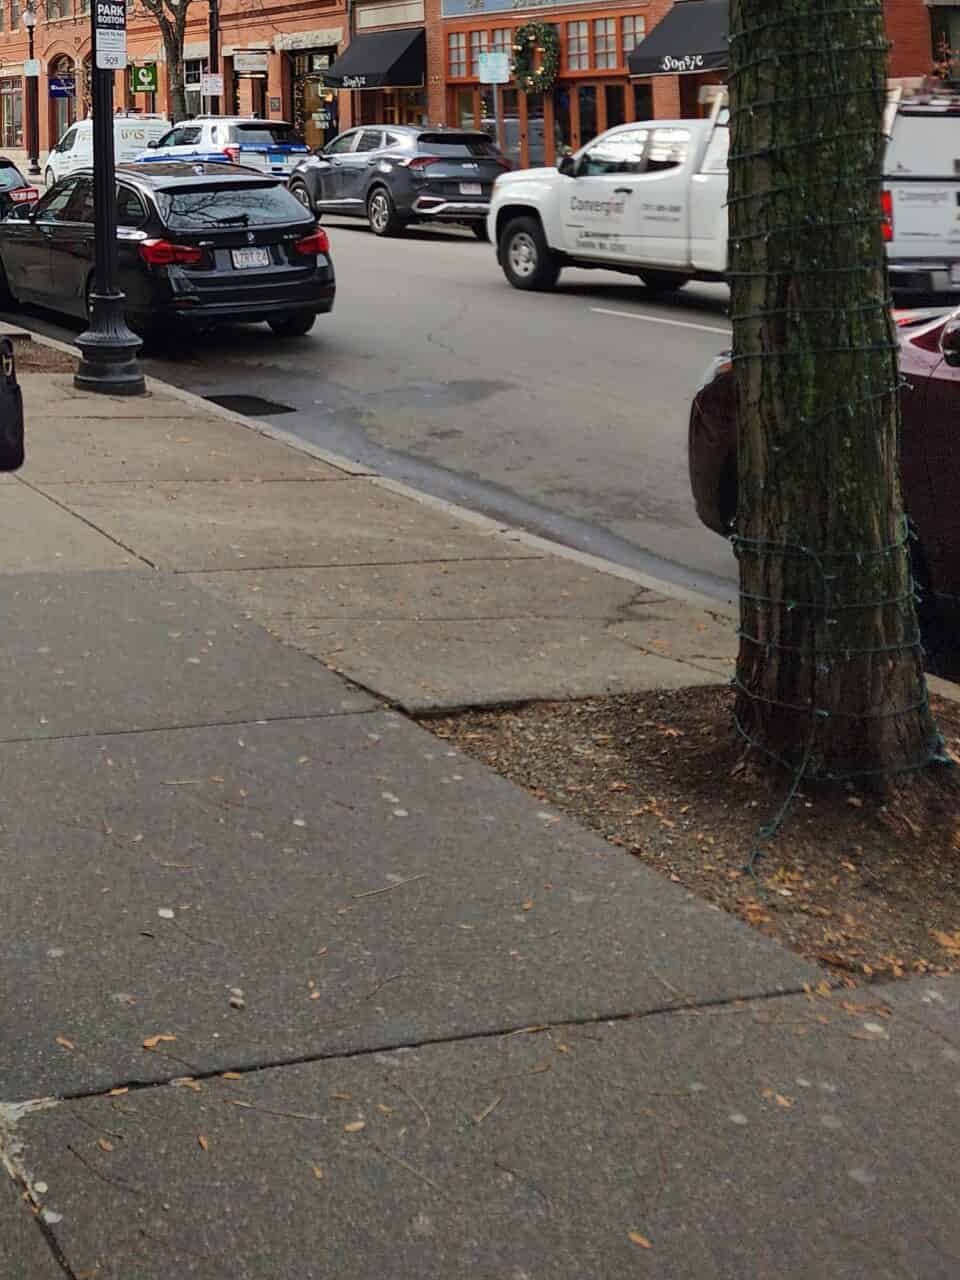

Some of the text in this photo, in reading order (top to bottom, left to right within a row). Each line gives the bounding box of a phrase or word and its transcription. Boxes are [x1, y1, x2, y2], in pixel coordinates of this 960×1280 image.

[97, 3, 124, 17] PARK
[97, 15, 125, 25] BOSTON
[662, 55, 705, 71] Sonsie
